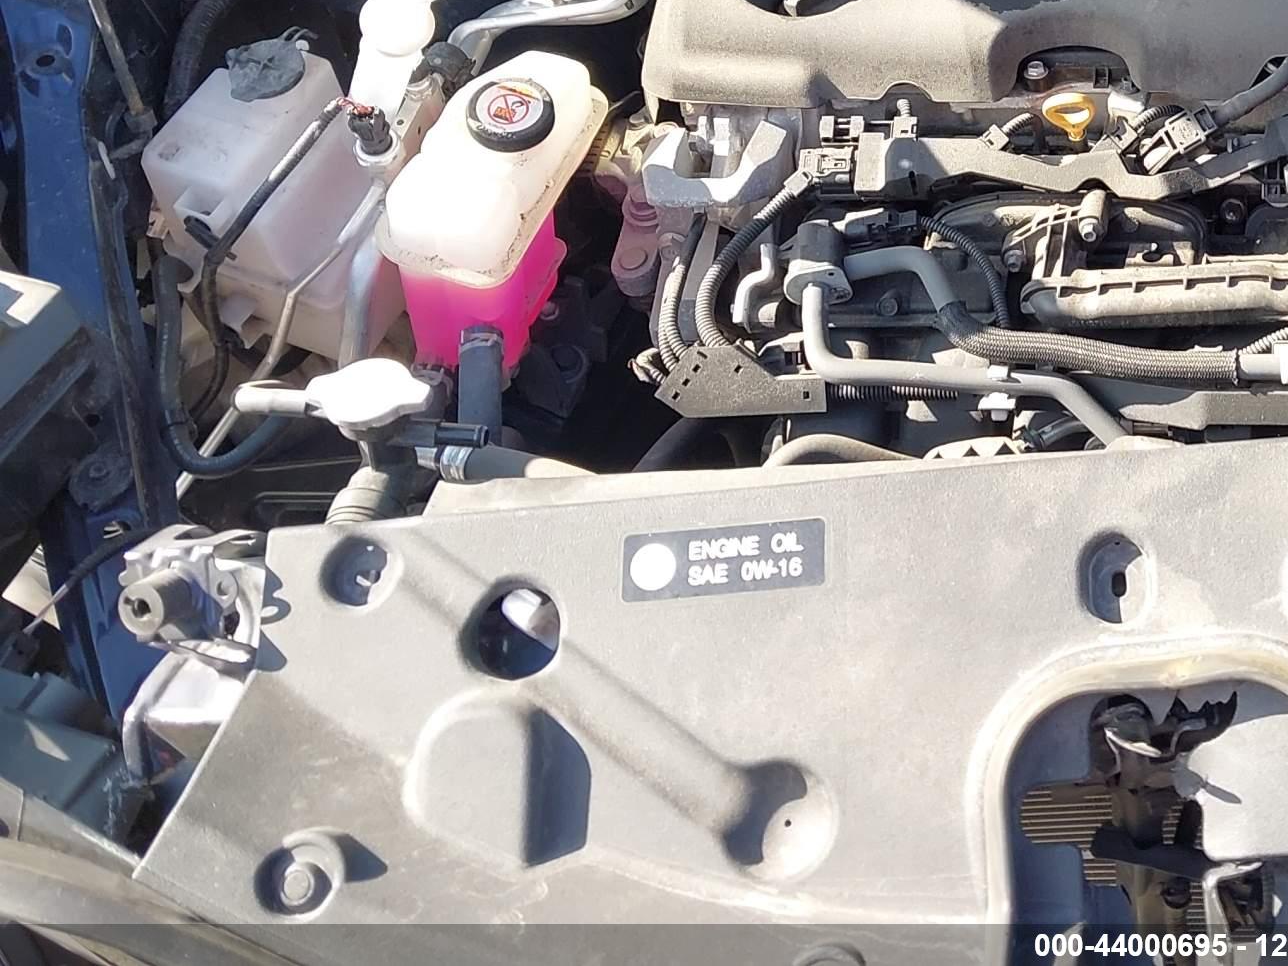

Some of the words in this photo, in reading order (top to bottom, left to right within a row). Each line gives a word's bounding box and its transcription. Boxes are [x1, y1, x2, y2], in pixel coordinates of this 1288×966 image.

[689, 535, 760, 561] ENGINE
[771, 532, 804, 553] OIL
[688, 563, 729, 586] SAE
[741, 556, 803, 581] 0W-16
